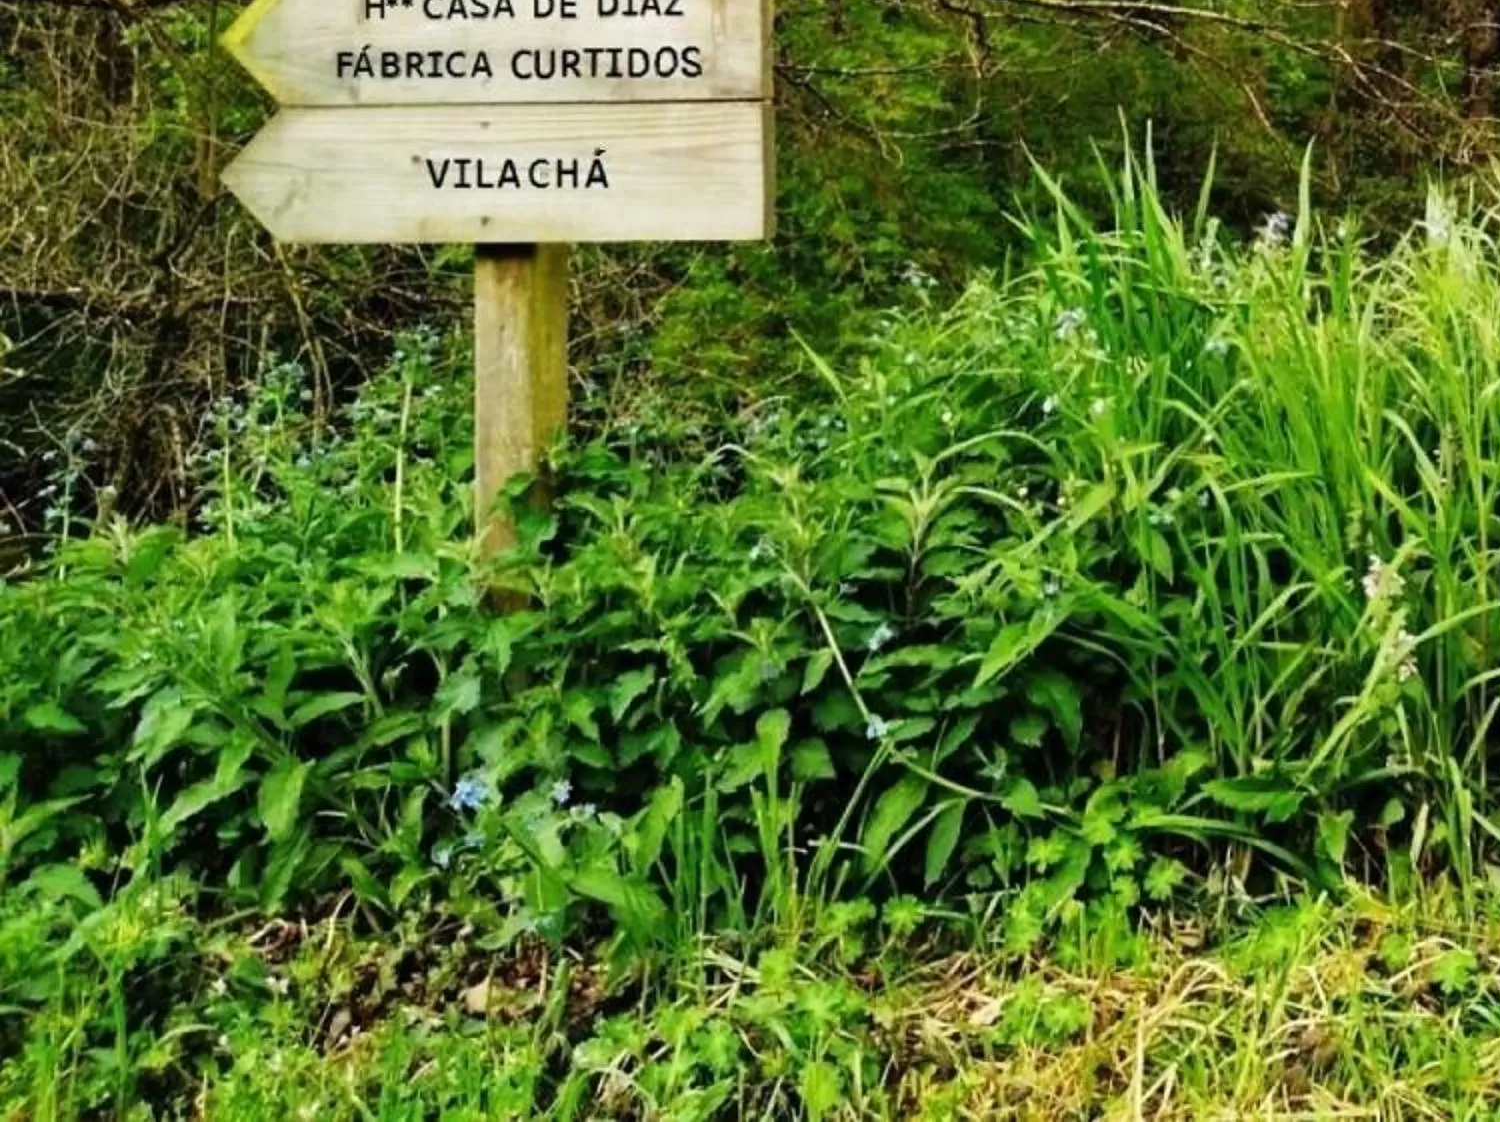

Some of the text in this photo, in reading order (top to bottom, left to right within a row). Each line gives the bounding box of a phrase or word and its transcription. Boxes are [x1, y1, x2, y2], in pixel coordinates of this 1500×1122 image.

[336, 43, 703, 79] FÁBRICA CURTIDOS
[426, 148, 610, 189] VILACHÁ
